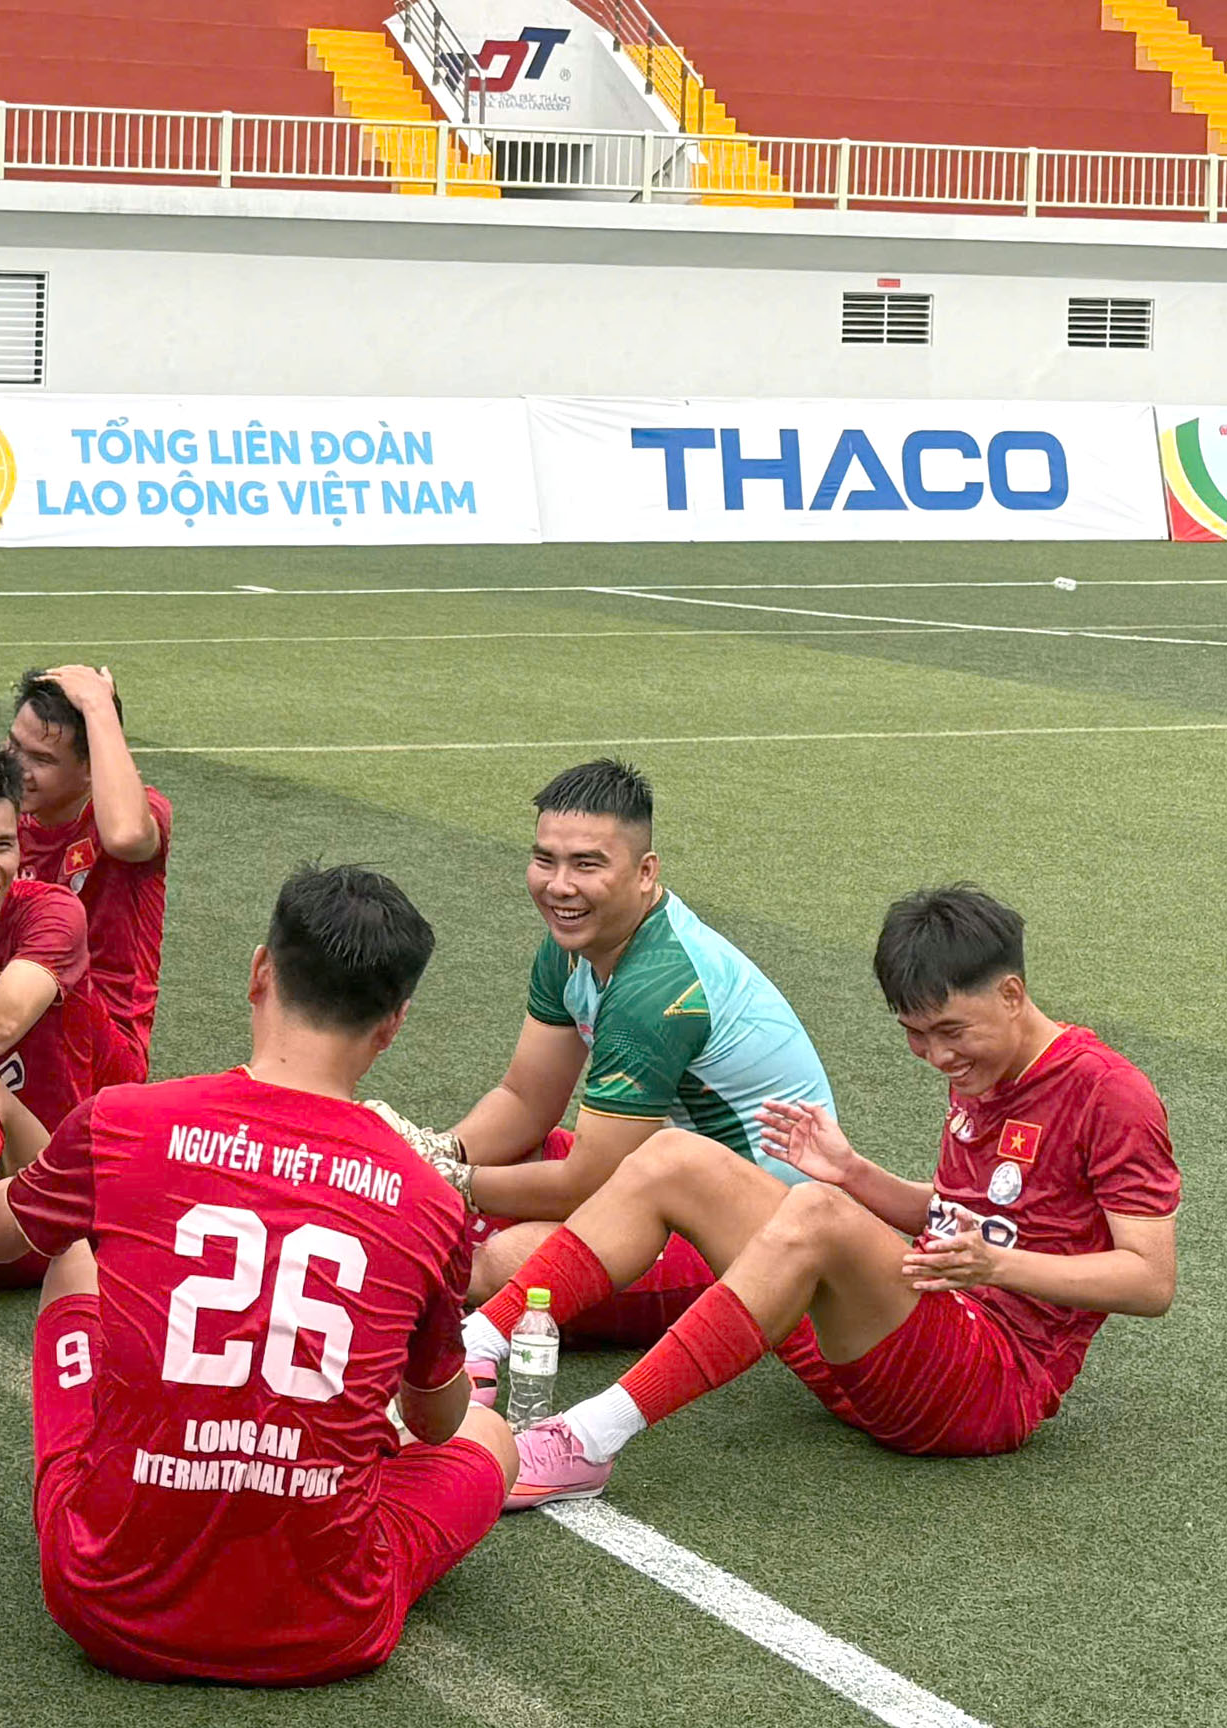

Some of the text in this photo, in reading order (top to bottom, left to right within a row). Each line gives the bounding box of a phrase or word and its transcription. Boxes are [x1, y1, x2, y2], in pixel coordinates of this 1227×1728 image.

[71, 416, 433, 465] TỔNG LIÊN ĐOÀN
[631, 427, 1069, 511] THACO
[37, 470, 477, 528] LAO ĐỘNG VIỆT NAM
[167, 1123, 403, 1207] NGUYỄN VIỆT HOÀNG
[162, 1203, 369, 1403] 26
[55, 1330, 93, 1390] 9
[288, 1465, 345, 1498] PORT
